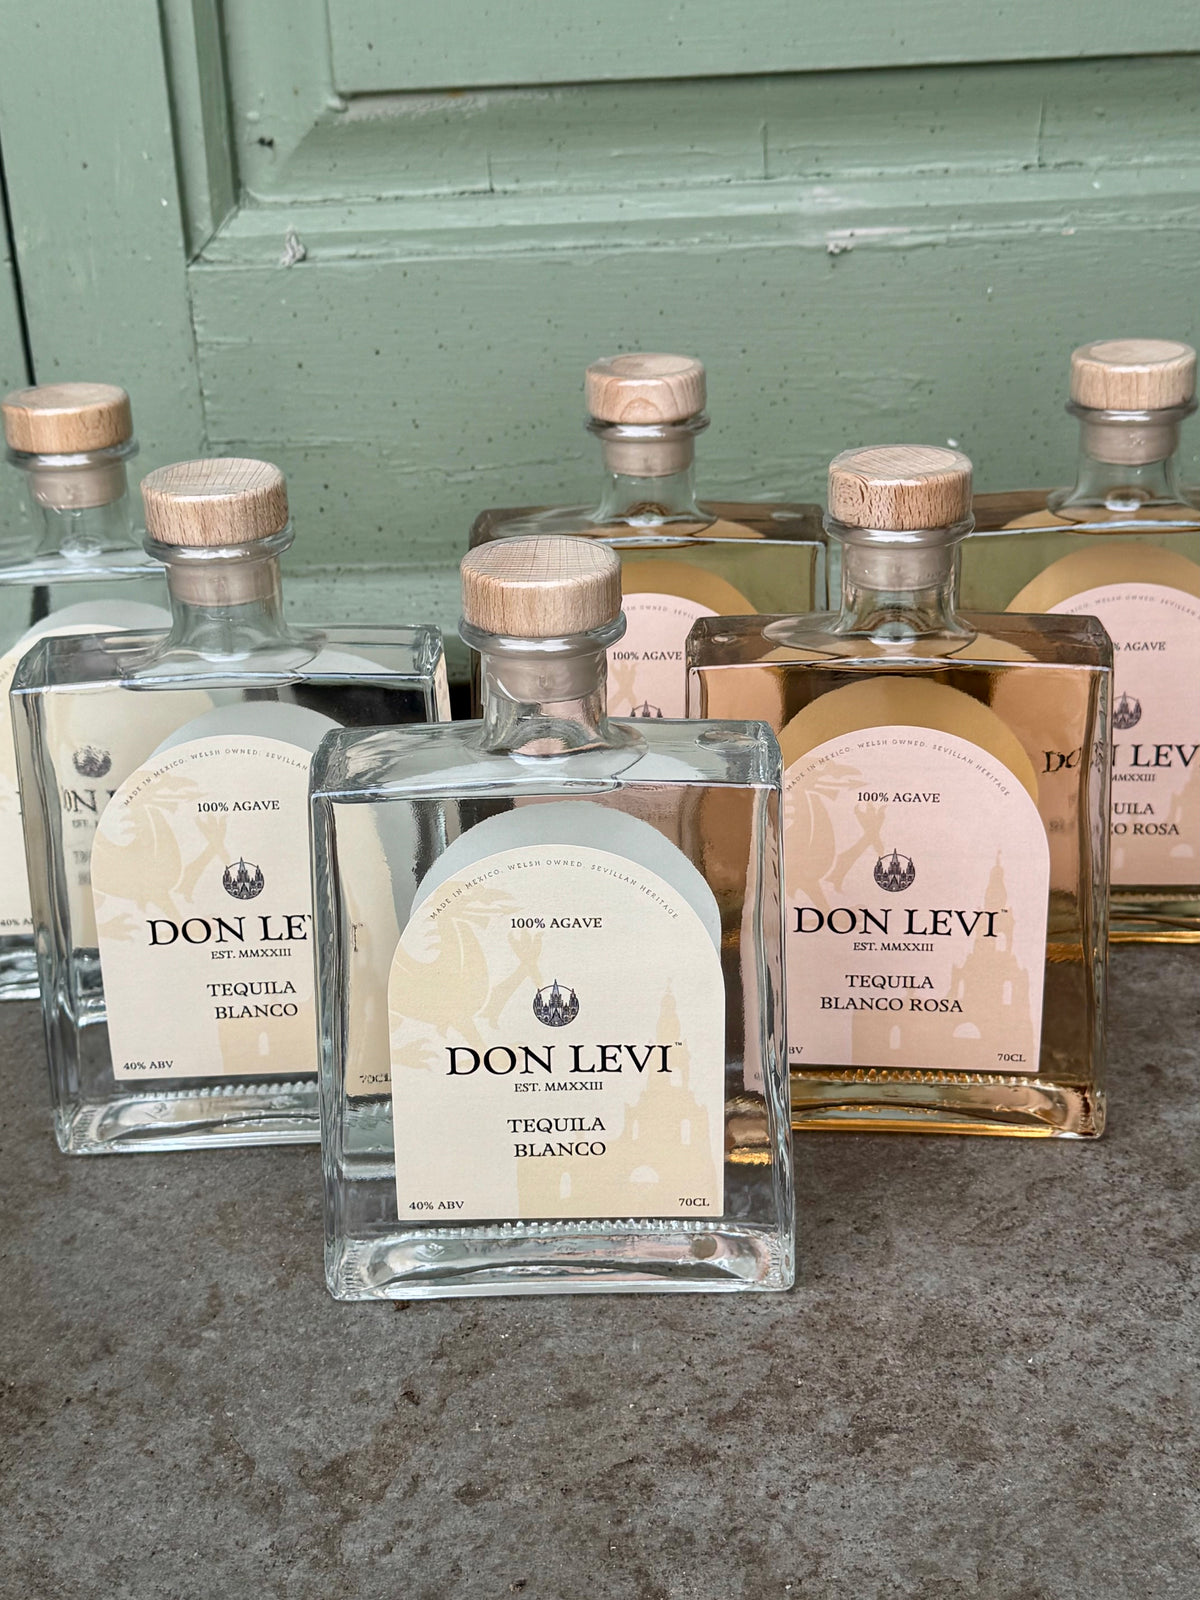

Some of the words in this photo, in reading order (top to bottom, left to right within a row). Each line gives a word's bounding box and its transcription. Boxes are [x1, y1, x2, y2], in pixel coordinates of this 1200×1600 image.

[1124, 641, 1166, 652] AGAVE
[612, 651, 640, 661] 100%
[642, 651, 683, 661] AGAVE
[1131, 744, 1200, 768] LEV
[785, 772, 806, 792] MADE
[806, 763, 817, 774] IN
[857, 739, 888, 750] WELSH
[123, 786, 142, 807] MADE
[190, 749, 221, 761] WELSH
[857, 791, 889, 803] 100%
[892, 792, 941, 804] AGAVE
[197, 801, 229, 813] 100%
[232, 800, 280, 812] AGAVE
[1112, 802, 1155, 816] UILA
[1132, 822, 1180, 836] ROSA
[430, 897, 452, 921] MADE
[452, 887, 464, 899] IN
[507, 860, 542, 872] WELSH
[591, 864, 637, 887] SEVILLAN
[639, 884, 680, 920] HERITAGE
[510, 917, 546, 930] 100%
[549, 917, 603, 929] AGAVE
[793, 906, 893, 935] DON
[146, 916, 247, 946] DON
[257, 914, 312, 942] LE
[211, 949, 237, 960] EST.
[238, 948, 292, 959] MMXXIII
[853, 942, 878, 952] EST.
[880, 942, 934, 952] MMXXIII
[206, 980, 297, 997] TEQUILA
[845, 974, 934, 990] TEQUILA
[214, 1002, 299, 1020] BLANCO
[819, 996, 904, 1012] BLANCO
[908, 998, 963, 1013] ROSA
[445, 1045, 556, 1076] DON
[997, 1053, 1027, 1063] 70CL
[123, 1060, 147, 1071] 40%
[149, 1060, 174, 1070] ABV
[514, 1082, 541, 1093] EST.
[544, 1081, 603, 1092] MMXXIII
[507, 1117, 607, 1134] TEQUILA
[513, 1142, 607, 1158] BLANCO
[408, 1200, 434, 1211] 40%
[437, 1200, 465, 1211] ABV
[678, 1197, 711, 1208] 70CL
